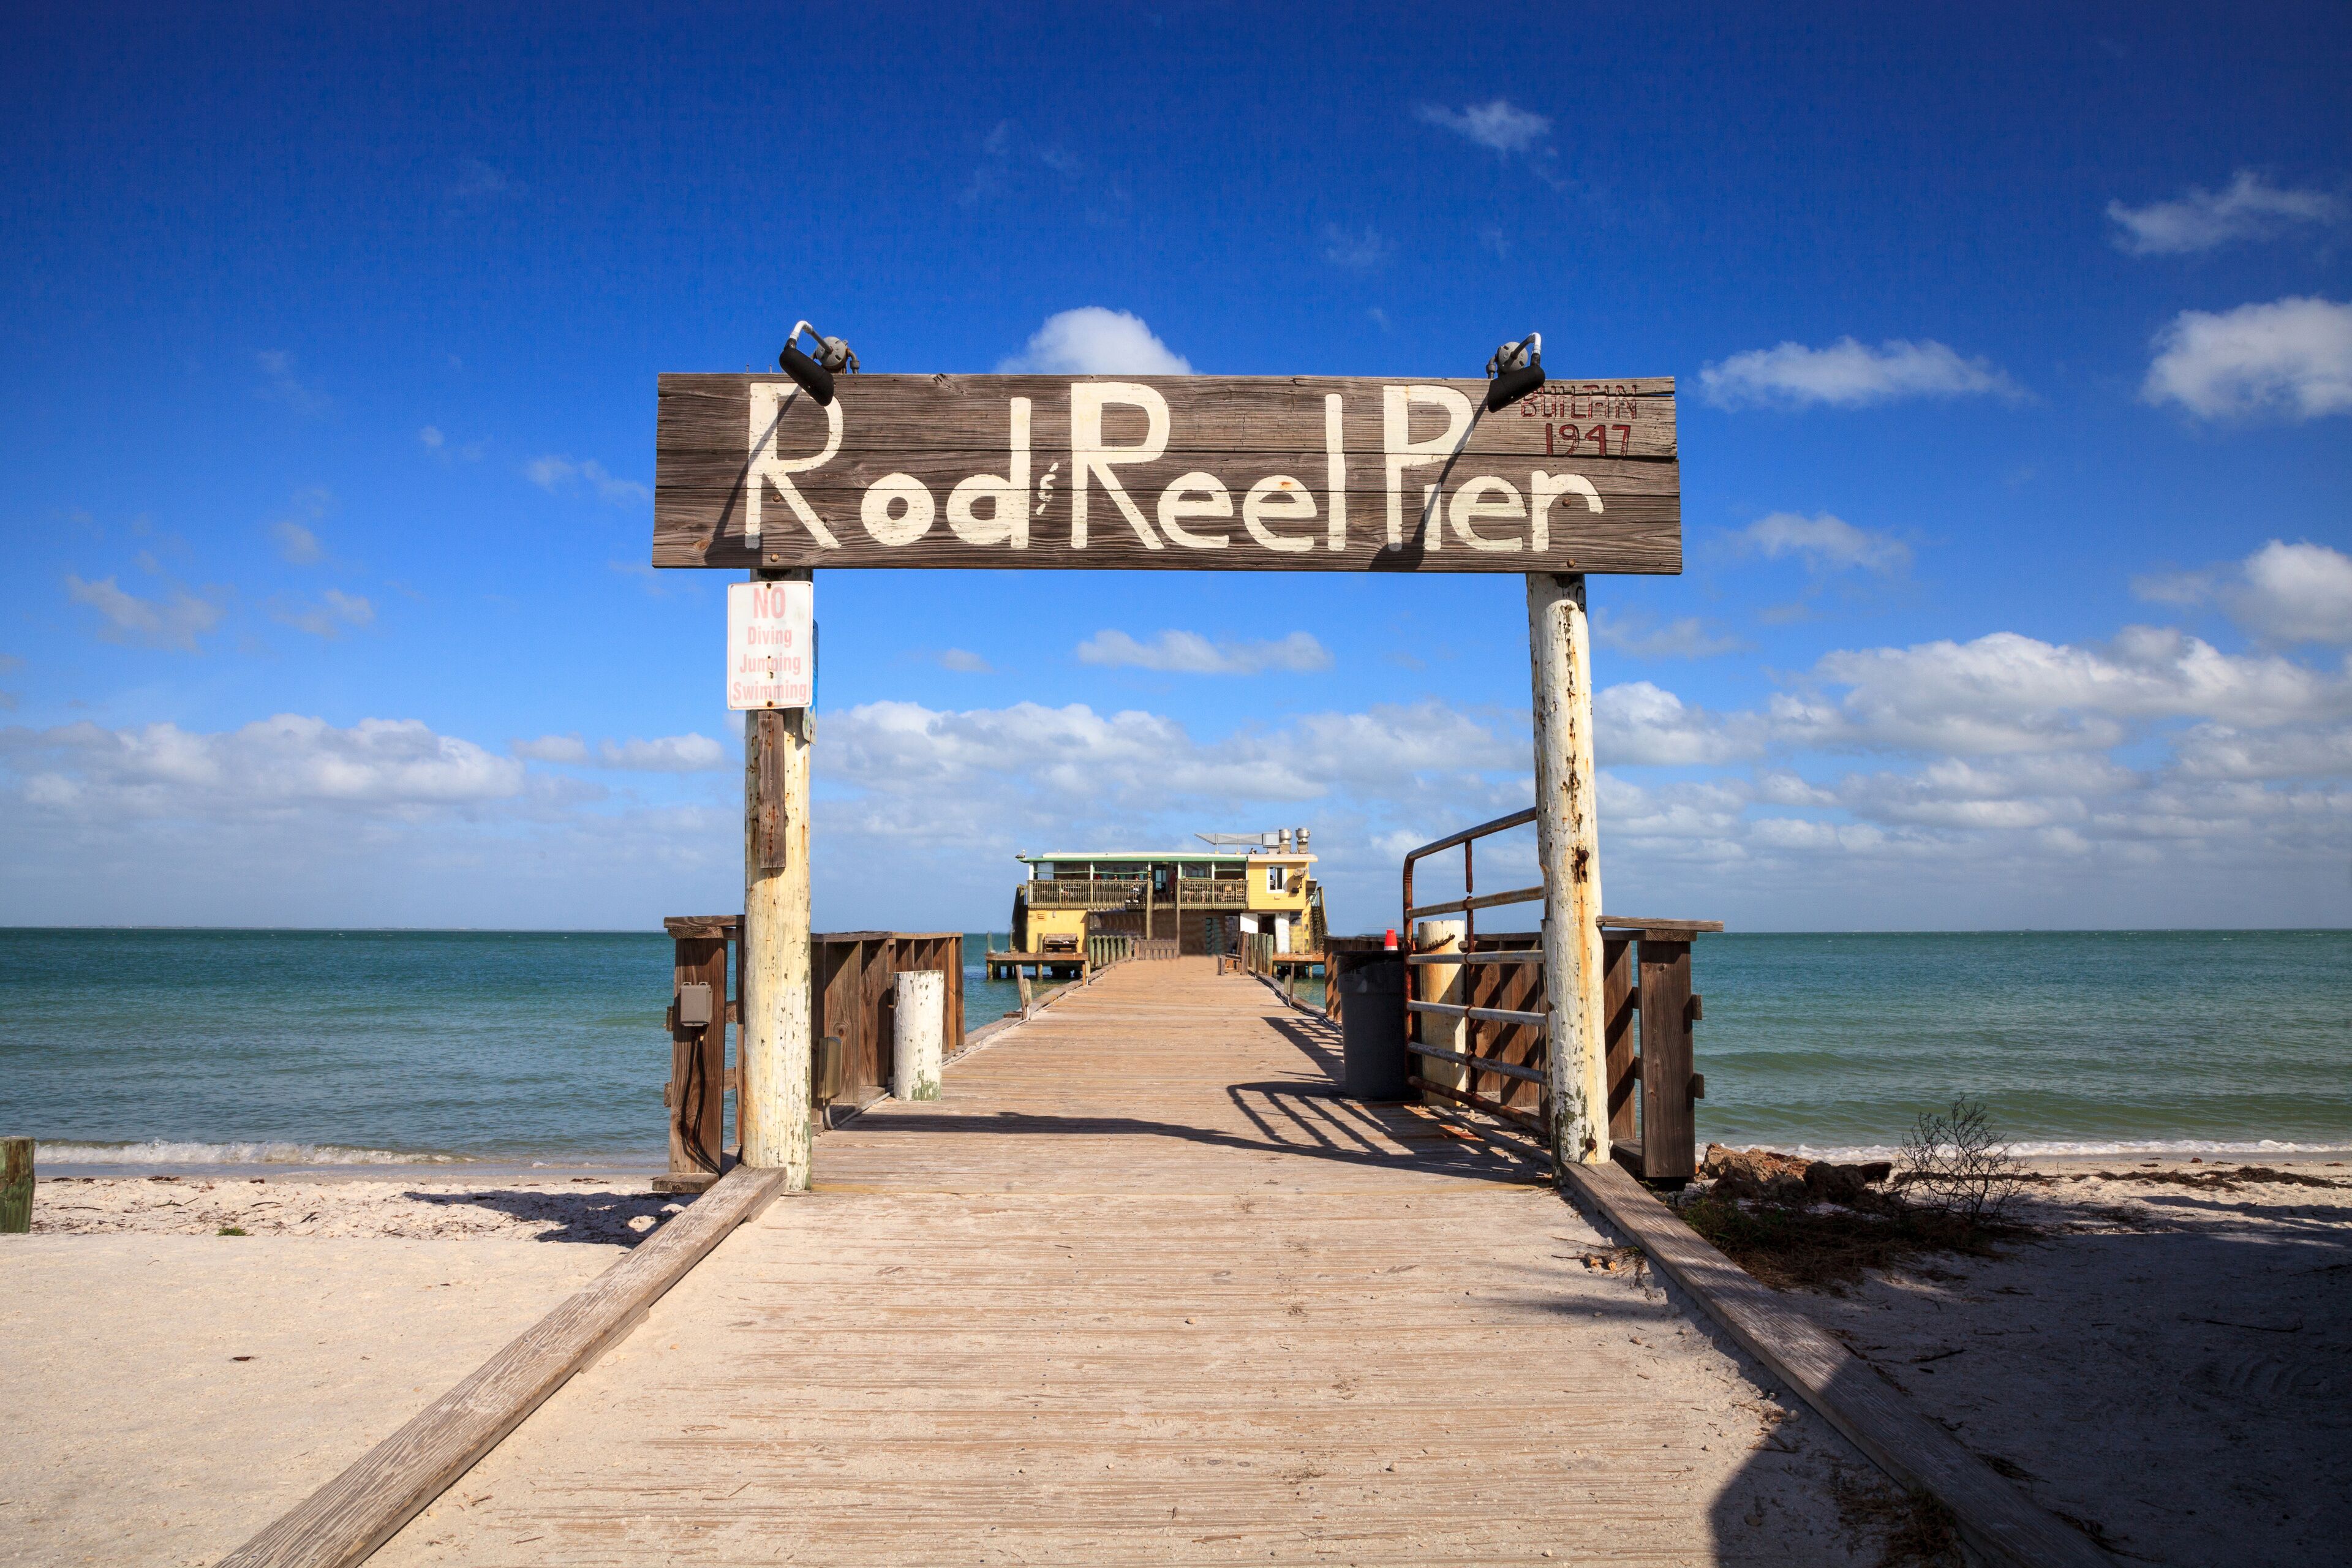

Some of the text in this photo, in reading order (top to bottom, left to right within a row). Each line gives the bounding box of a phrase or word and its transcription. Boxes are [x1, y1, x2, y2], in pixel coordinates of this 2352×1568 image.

[1545, 423, 1631, 457] 1947
[745, 382, 1031, 549] Rod
[1070, 382, 1348, 552] Reel
[1383, 384, 1605, 552] Pier
[753, 586, 786, 619] NO
[747, 625, 793, 648] Diving
[739, 652, 801, 676] Jumping
[733, 680, 807, 703] Swimming
